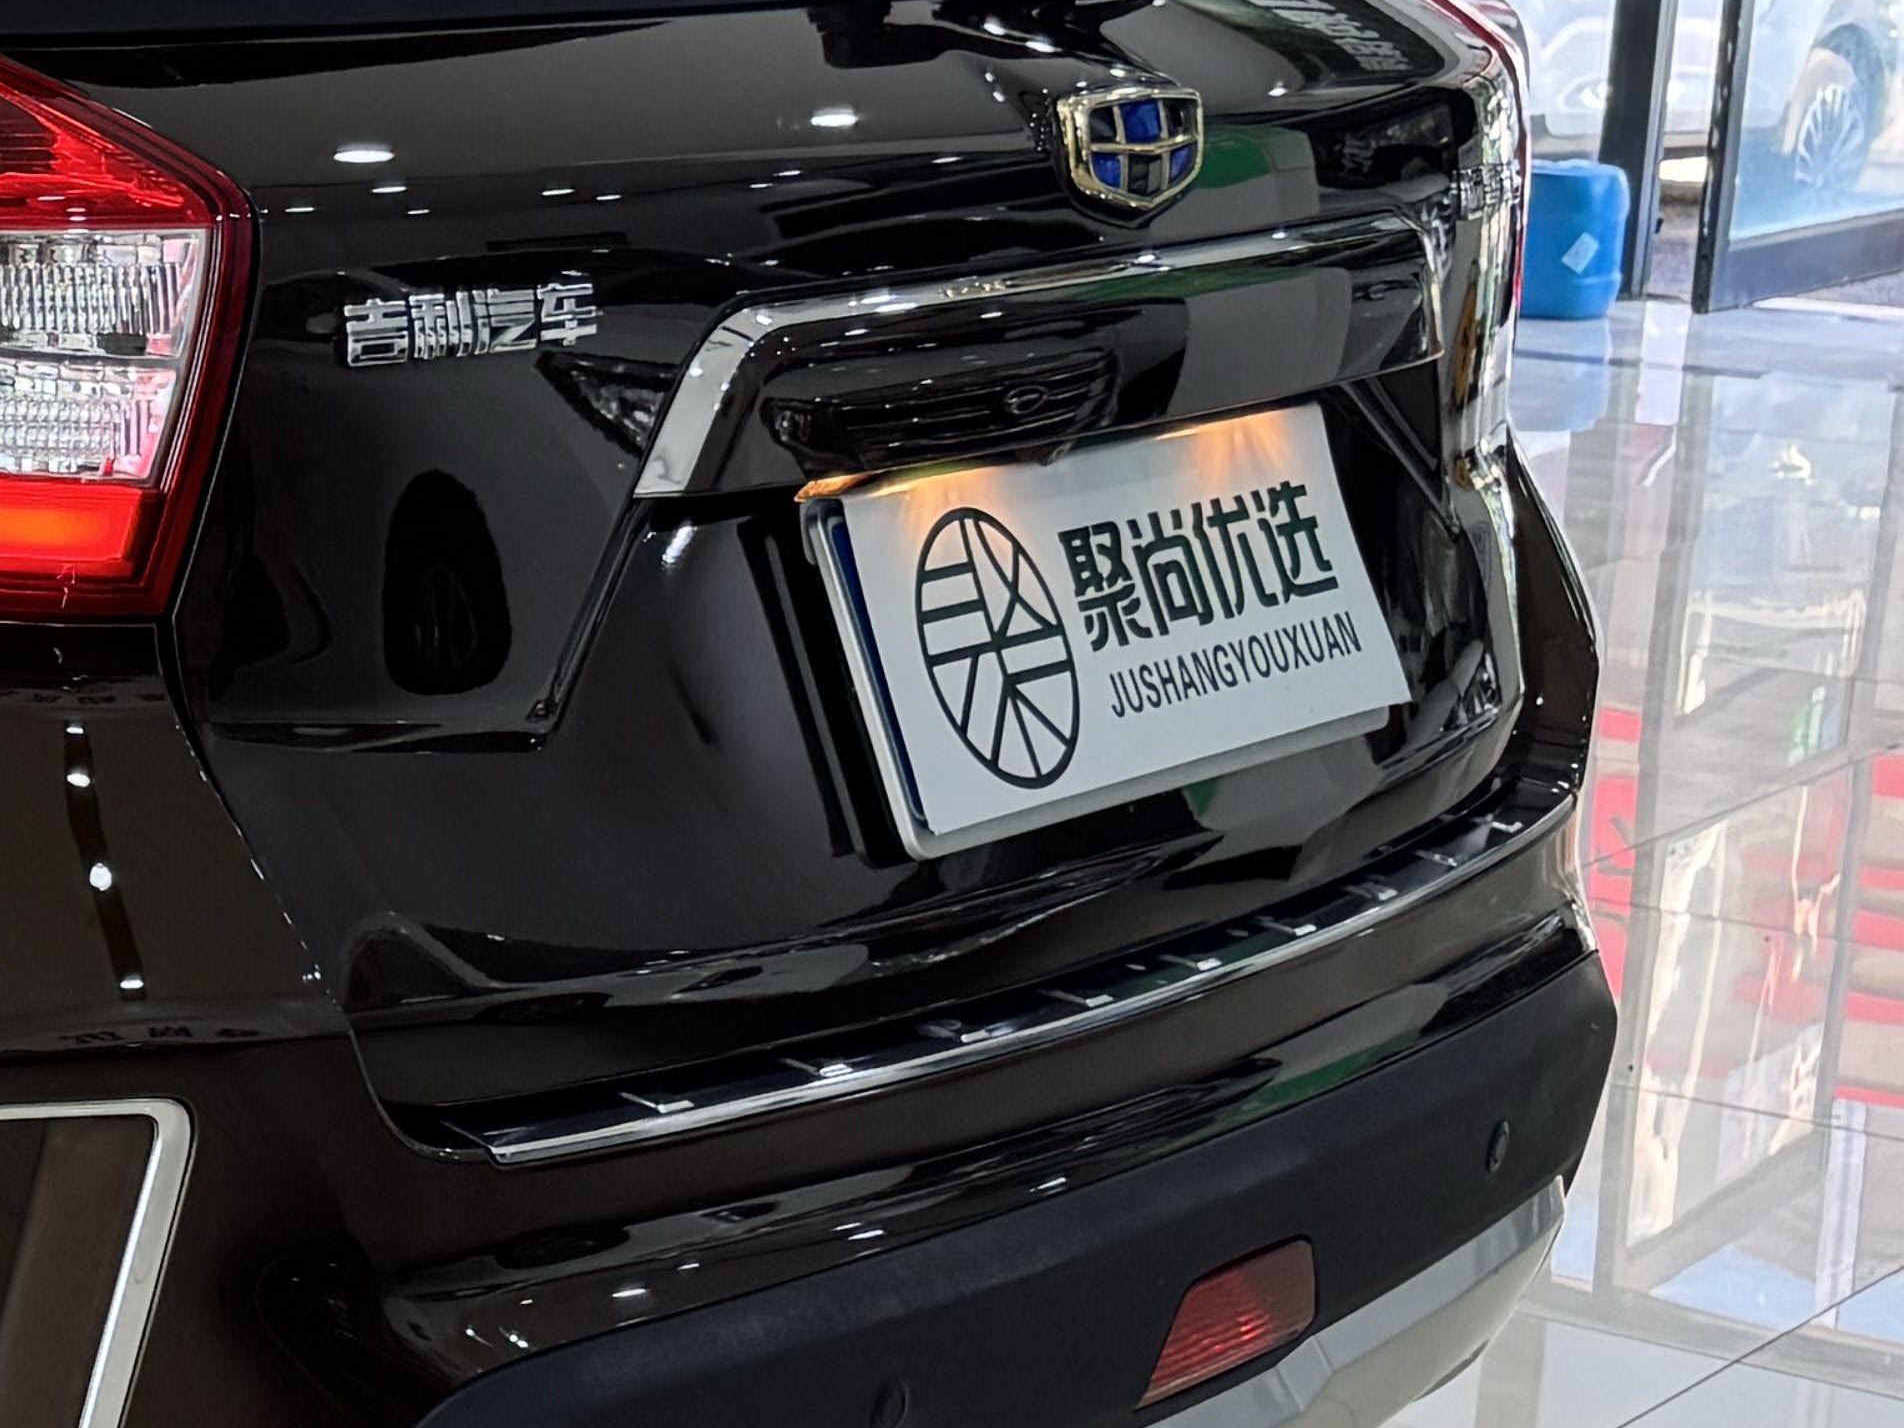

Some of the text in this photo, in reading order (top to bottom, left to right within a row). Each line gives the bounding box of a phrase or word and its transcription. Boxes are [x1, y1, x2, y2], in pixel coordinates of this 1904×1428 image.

[344, 282, 598, 368] 吉利汽车
[1057, 480, 1339, 653] 聚尚优选
[1109, 611, 1362, 719] JUSHANGYOUXUAN
